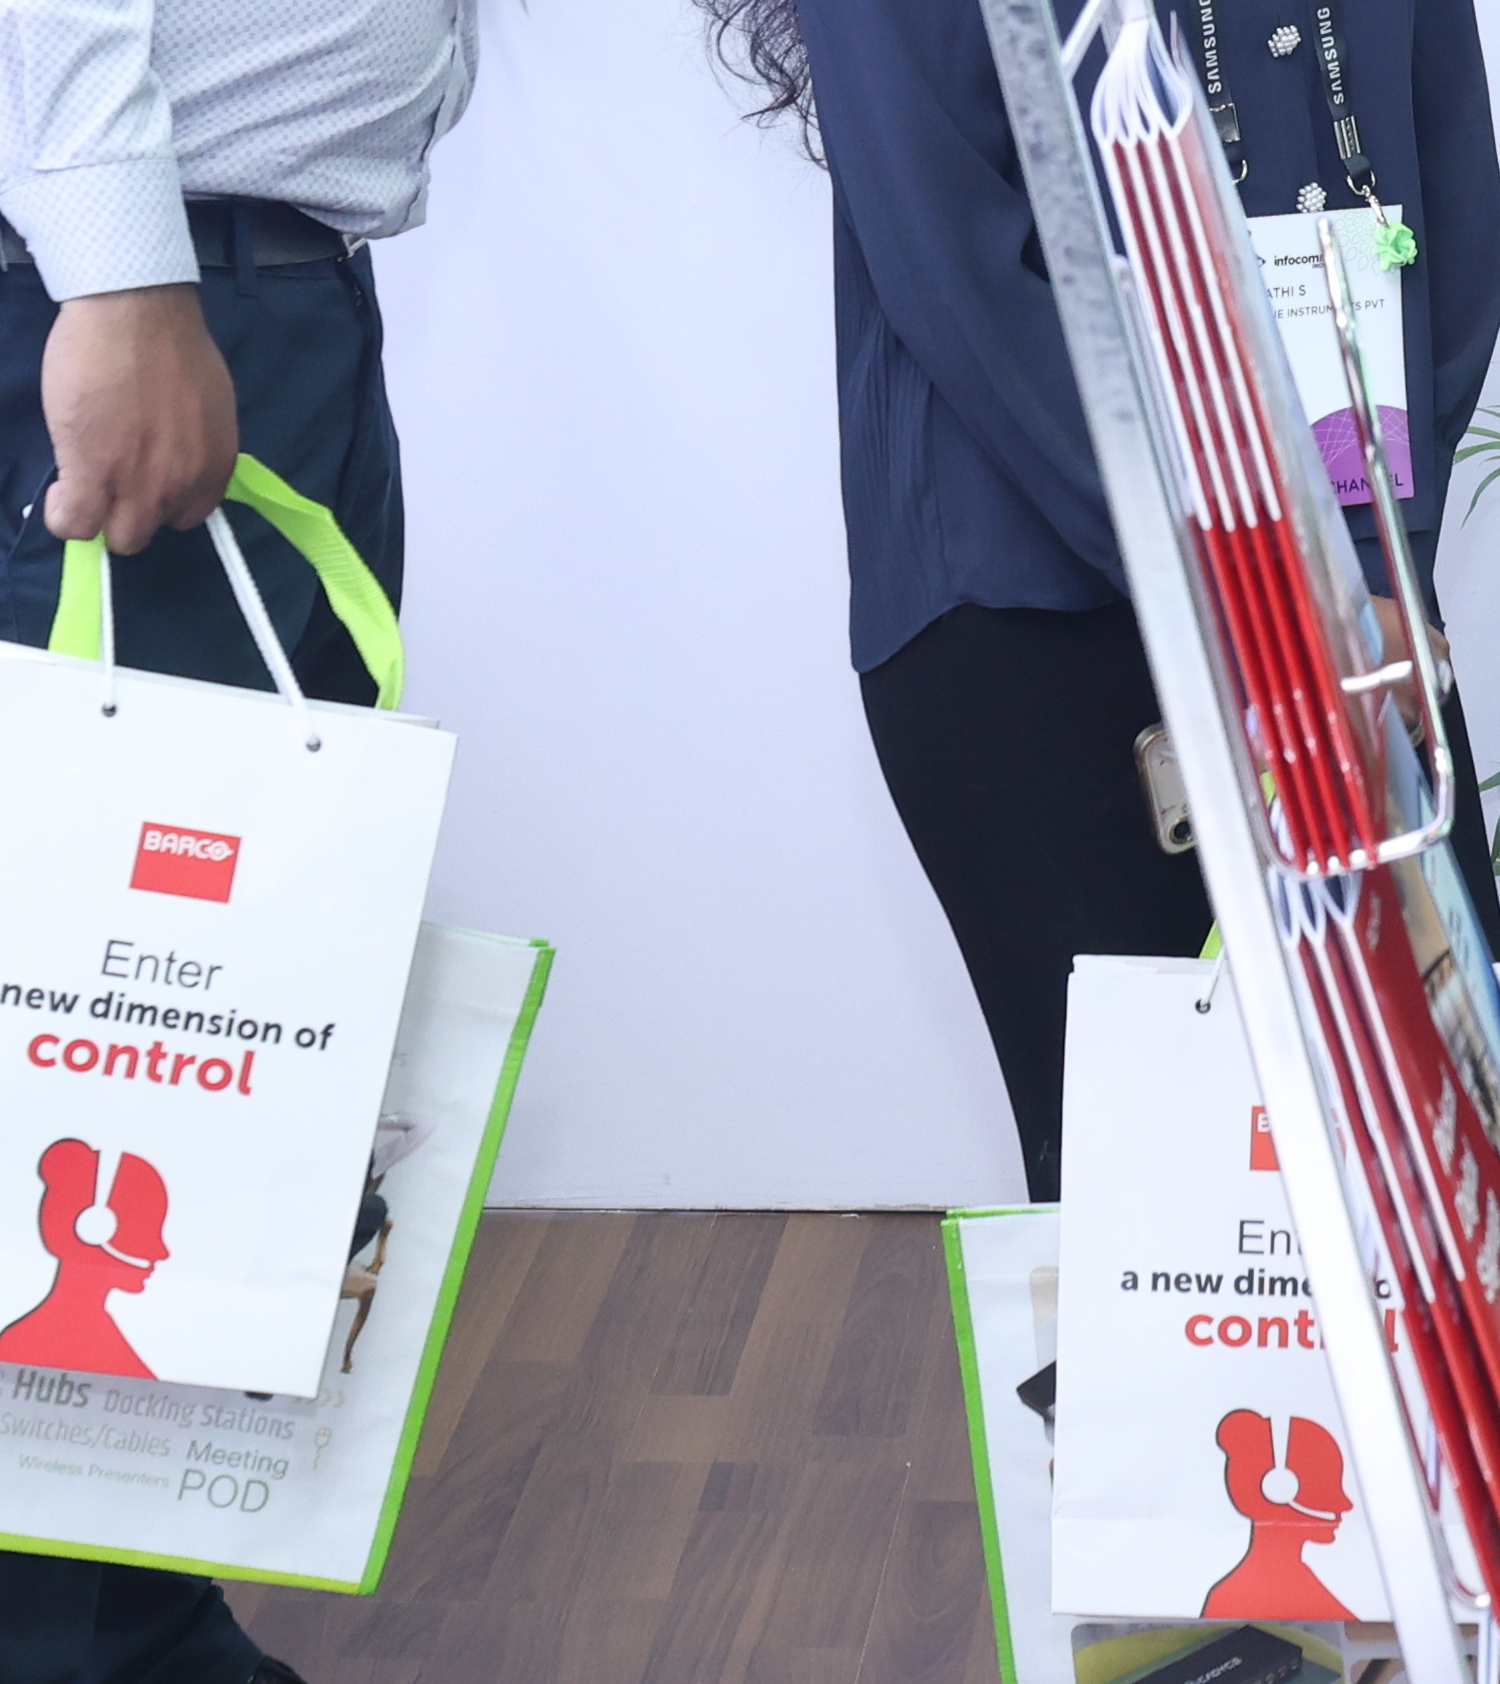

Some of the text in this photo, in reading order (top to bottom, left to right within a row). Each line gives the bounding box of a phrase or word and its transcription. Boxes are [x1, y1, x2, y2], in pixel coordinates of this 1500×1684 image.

[1317, 6, 1345, 105] SAMSUNG
[1298, 284, 1307, 297] S
[1365, 298, 1385, 311] PVT
[142, 829, 234, 862] BARCO
[100, 939, 223, 991] Enter
[0, 982, 81, 1014] new
[89, 991, 283, 1045] dimension
[294, 1022, 336, 1051] of
[27, 1033, 256, 1096] control
[1120, 1269, 1139, 1292] a
[1151, 1271, 1224, 1294] new
[1184, 1309, 1399, 1353] contl
[11, 1367, 93, 1409] Hubs
[0, 1412, 172, 1458] Switches/Cables
[103, 1389, 296, 1440] Docking Stations
[18, 1454, 171, 1489] Wireless Presenters
[186, 1439, 290, 1482] Meeting
[177, 1468, 271, 1514] POD
